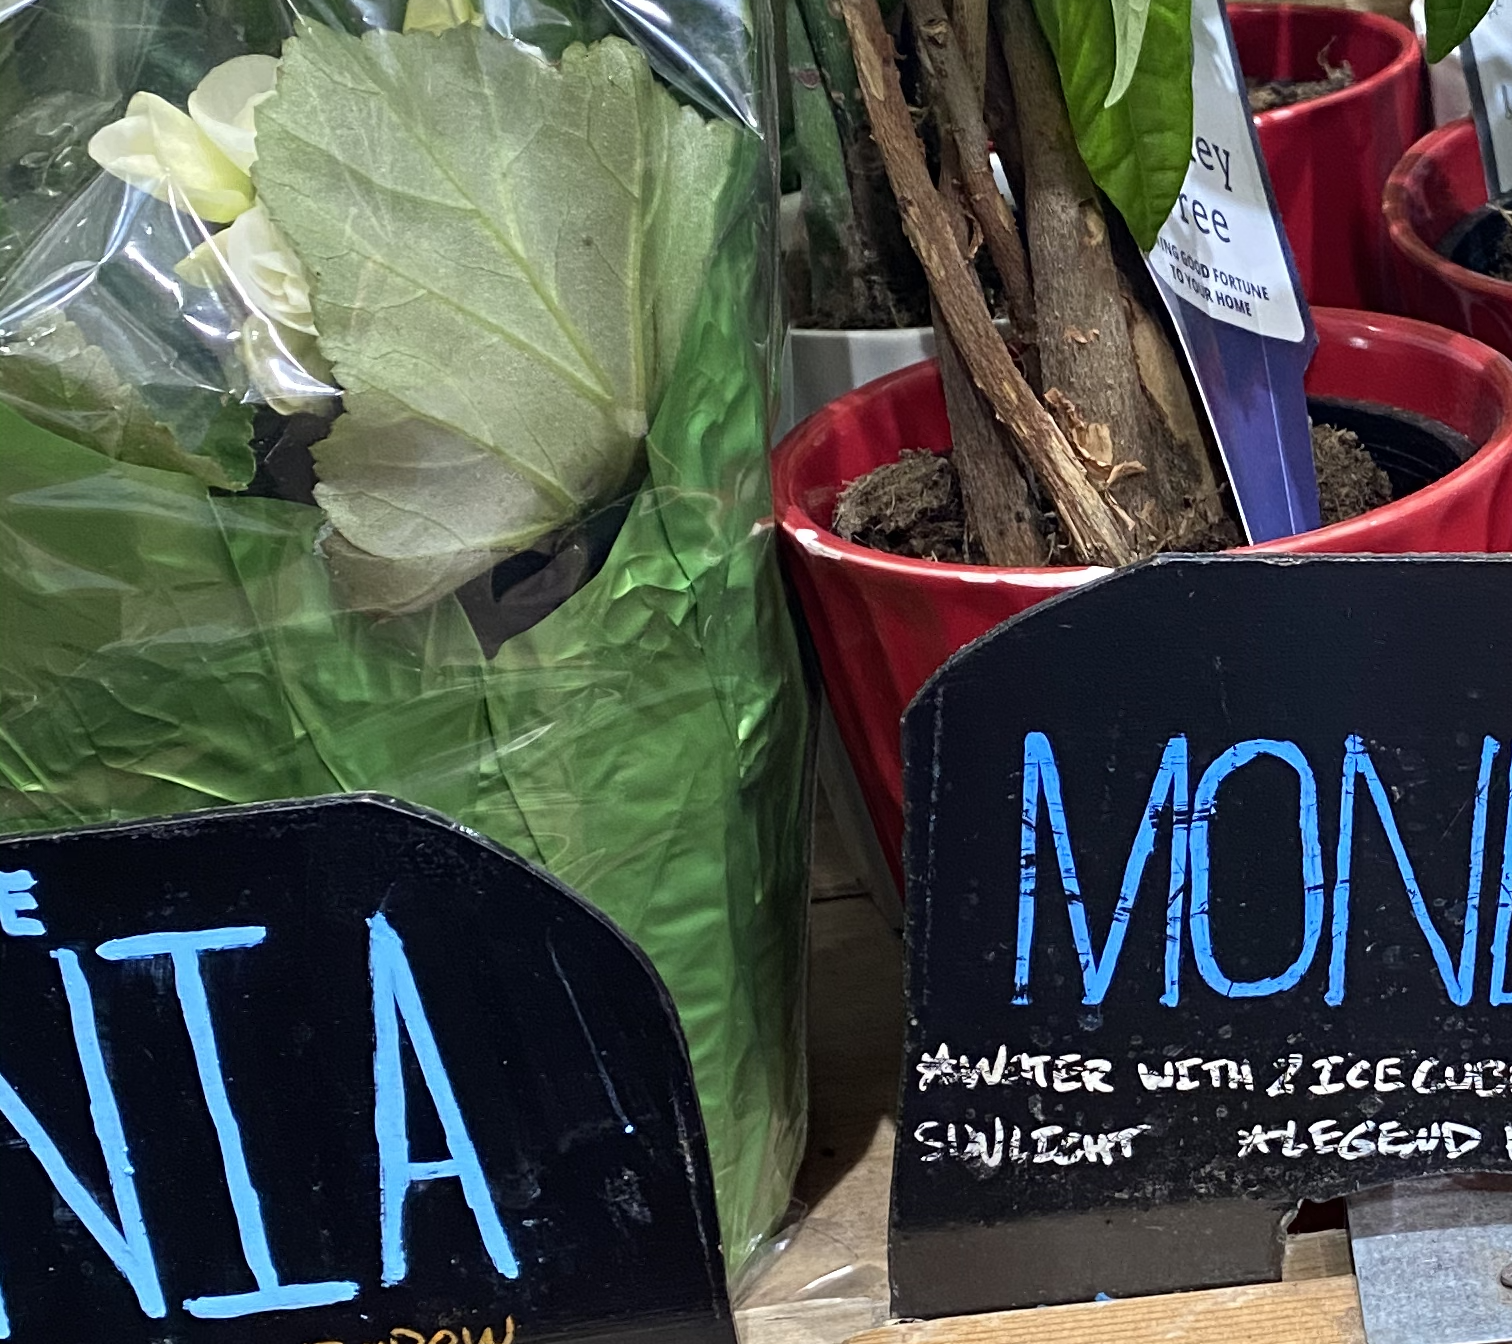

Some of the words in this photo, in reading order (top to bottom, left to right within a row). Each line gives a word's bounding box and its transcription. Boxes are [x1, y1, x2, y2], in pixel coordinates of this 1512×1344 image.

[1179, 193, 1232, 243] ree
[1157, 236, 1180, 261] ING
[1180, 250, 1210, 279] GOOD
[1212, 267, 1270, 301] FORTUNE
[1169, 263, 1184, 284] TO
[1184, 272, 1214, 303] YOUR
[1215, 290, 1252, 317] HOME
[1137, 1056, 1255, 1093] WITH
[1280, 1120, 1483, 1161] LEGEND
